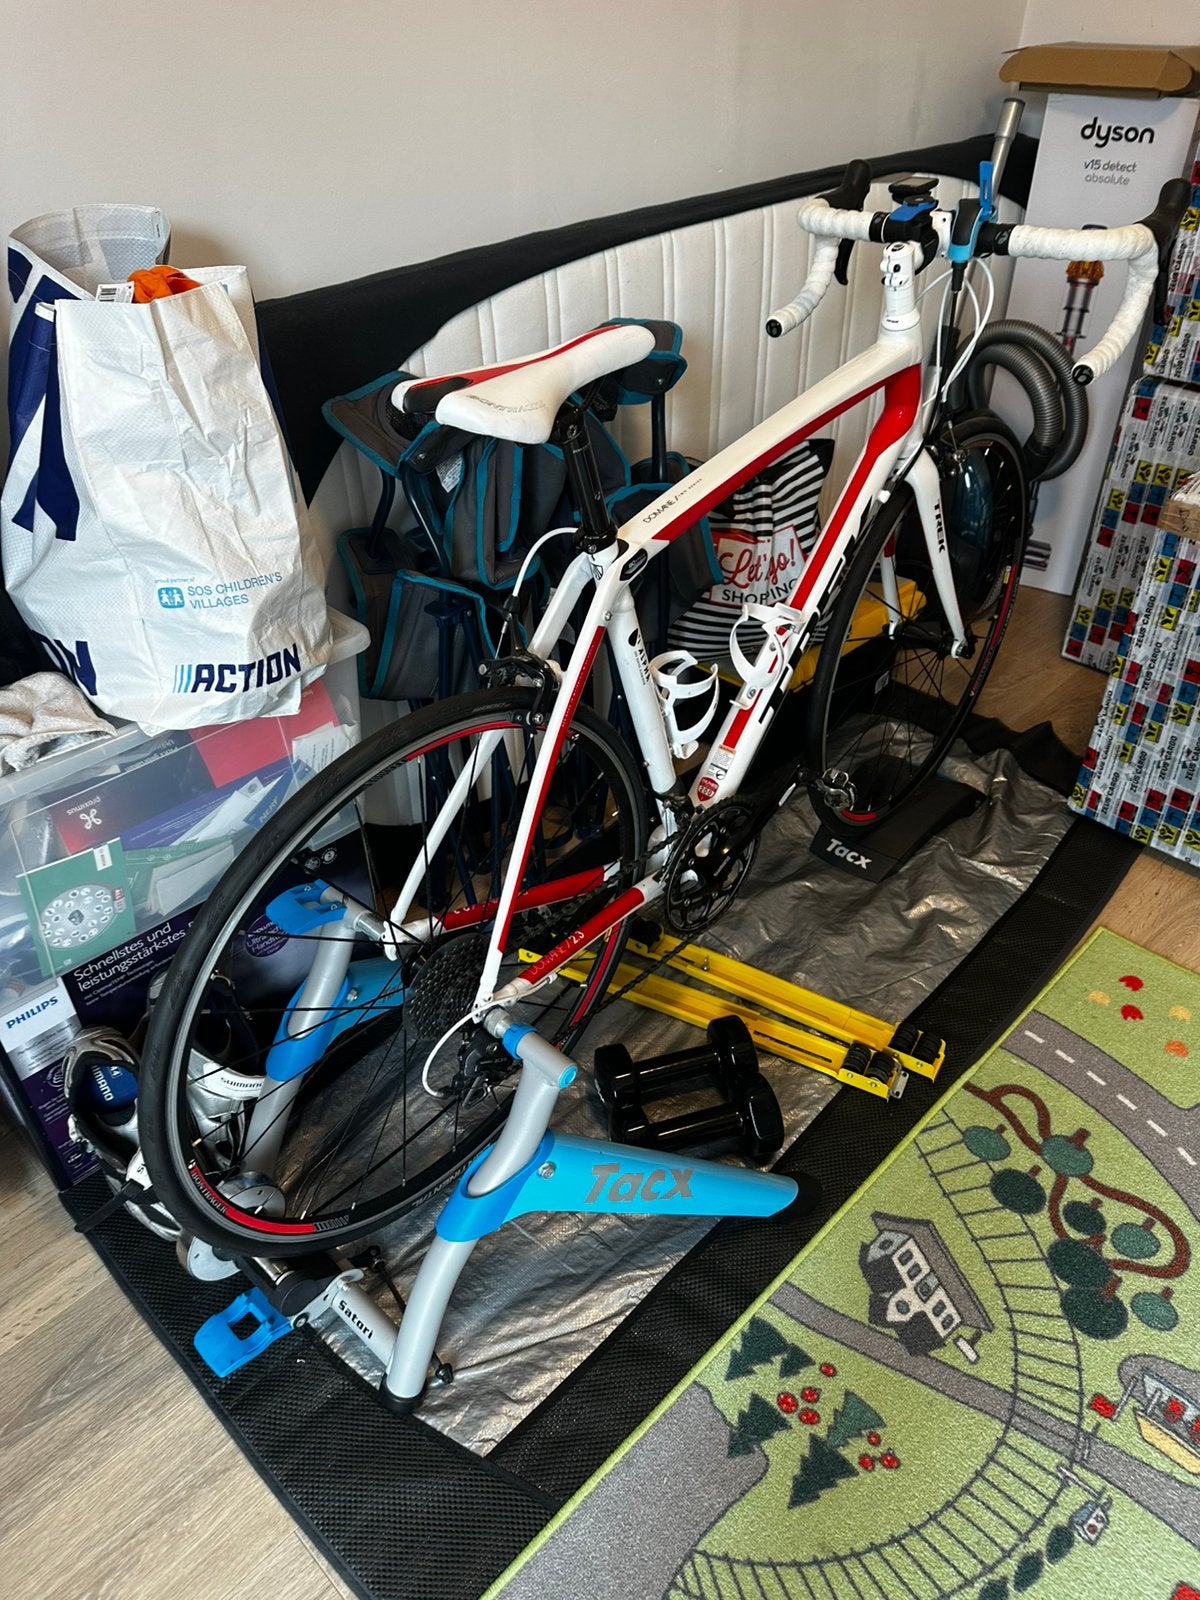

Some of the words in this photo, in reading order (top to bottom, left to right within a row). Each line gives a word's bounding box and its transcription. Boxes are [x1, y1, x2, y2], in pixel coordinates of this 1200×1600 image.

[1080, 116, 1155, 148] dyson
[1084, 159, 1101, 170] v15
[1102, 160, 1137, 173] detect
[1085, 173, 1130, 185] absolute
[933, 499, 946, 553] TREK
[187, 585, 213, 596] SOS
[215, 571, 283, 594] CHILDREN'S
[190, 594, 249, 609] VILLAGES
[1134, 625, 1147, 648] ZEUS
[1143, 595, 1157, 625] CARGO
[190, 643, 302, 694] ACTION
[1142, 669, 1153, 690] ZEUS
[1149, 642, 1163, 669] CARGO
[1130, 775, 1140, 793] ZEUS
[1136, 751, 1148, 774] CARGO
[1159, 761, 1170, 780] ZEUS
[1165, 735, 1178, 760] CARGO
[1185, 762, 1197, 780] ZEUS
[66, 795, 101, 816] proximus
[1101, 796, 1112, 814] ZEUS
[1107, 771, 1120, 796] CARGO
[826, 838, 872, 869] Tacx
[74, 938, 144, 981] Schnellstes
[147, 922, 172, 943] und
[78, 929, 187, 992] leistungsstärkstes
[6, 996, 59, 1029] PHILIPS
[91, 1065, 114, 1101] IMANO
[584, 1162, 695, 1204] Tacx
[338, 1299, 373, 1339] Satori
